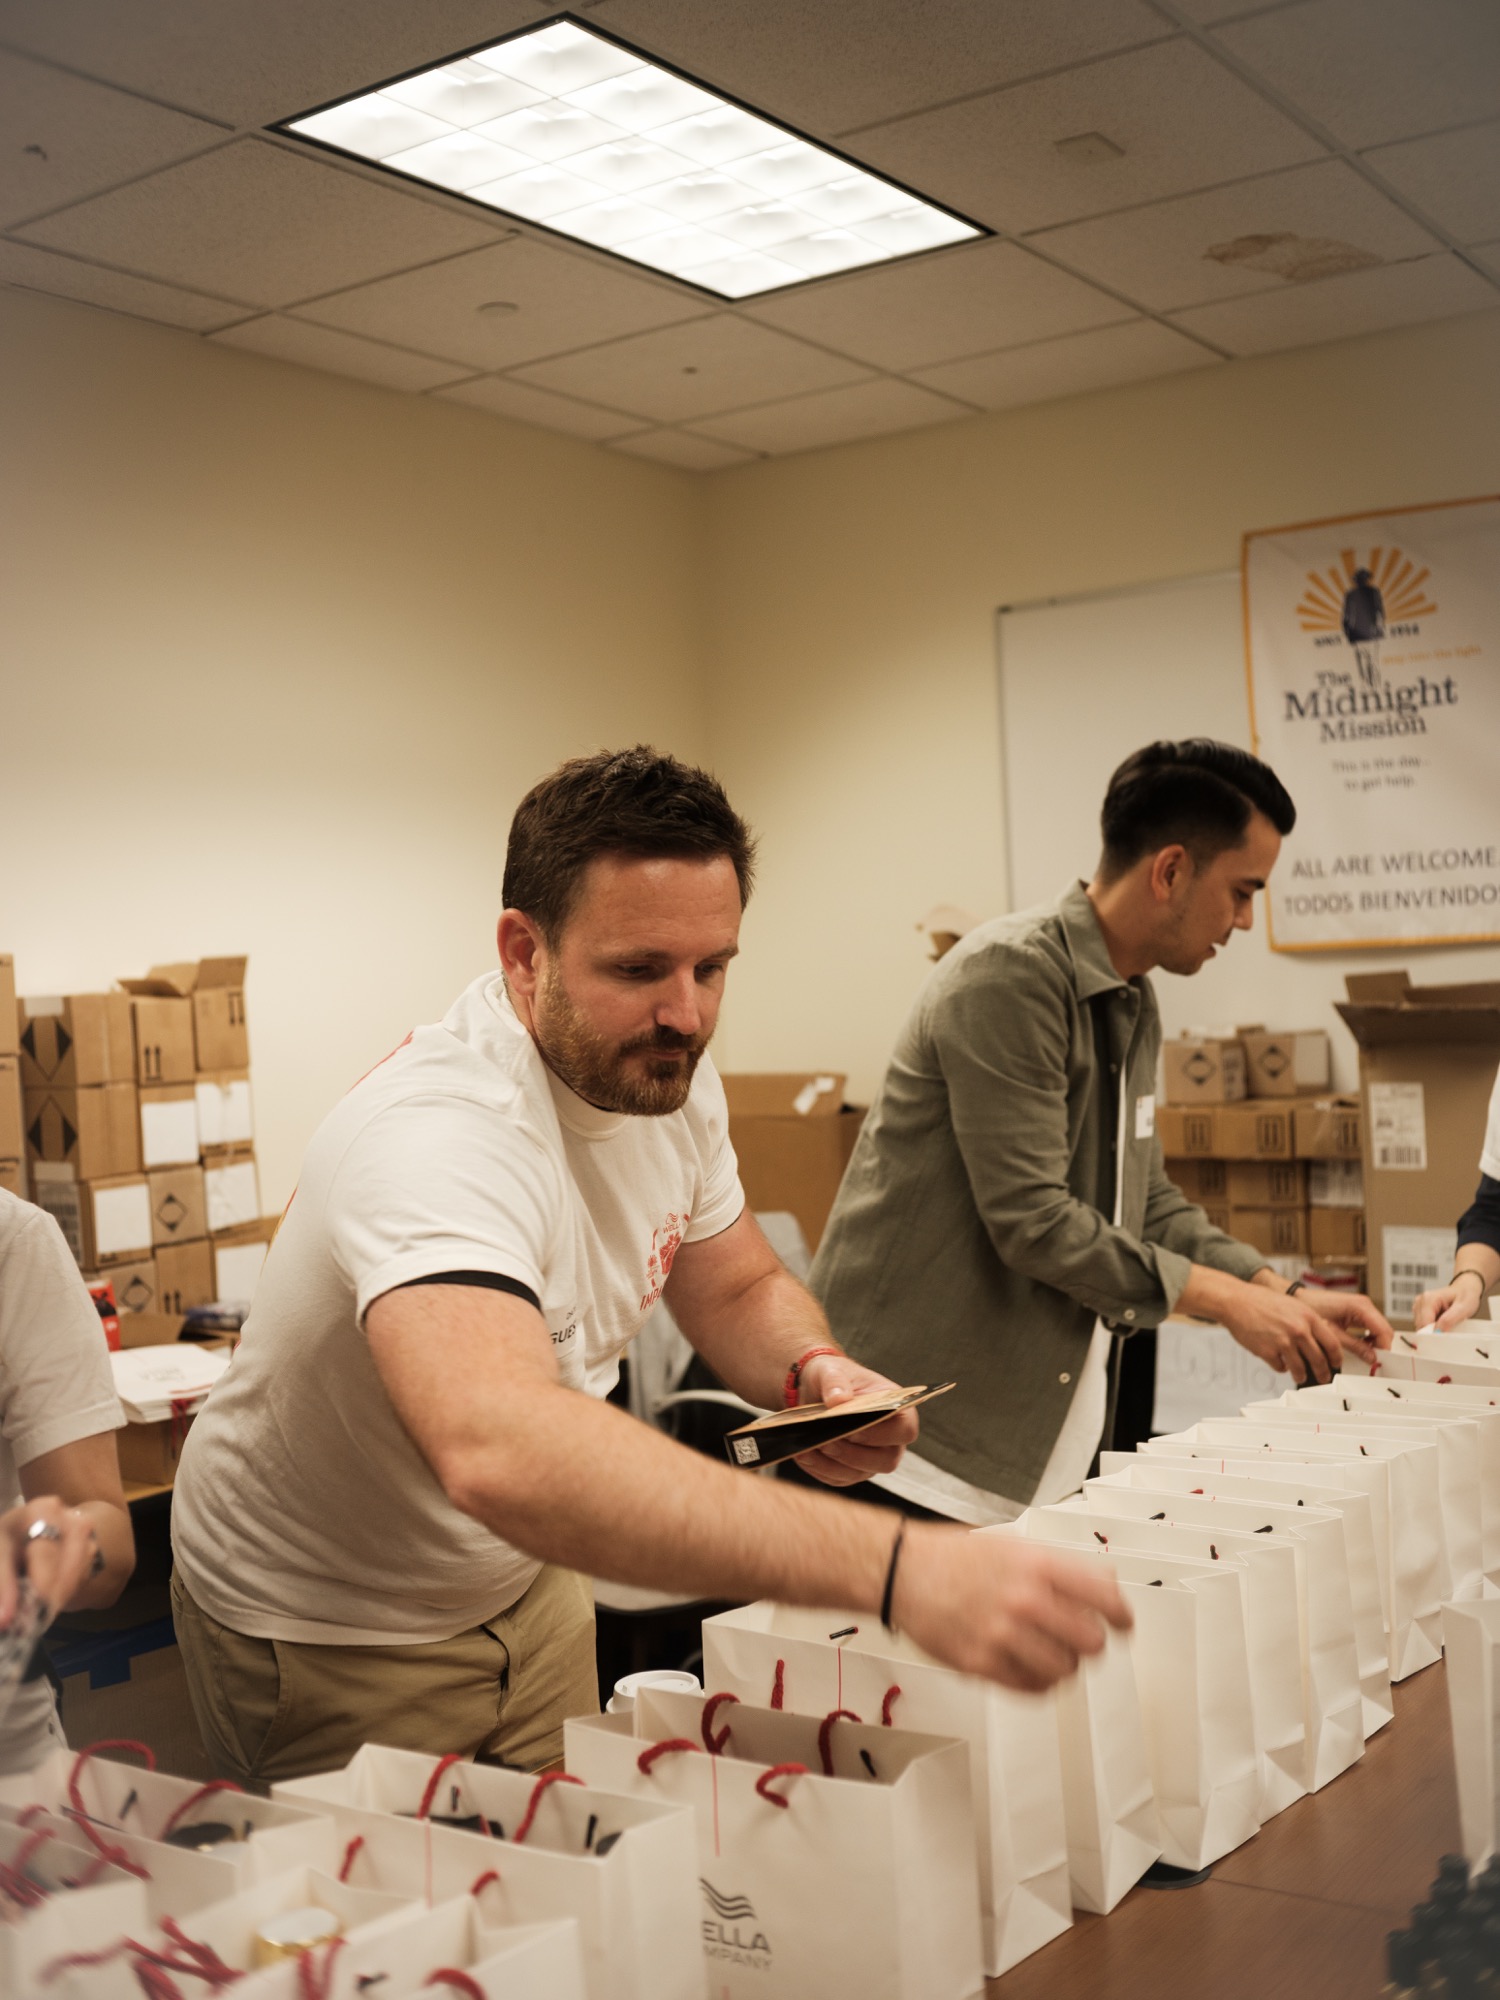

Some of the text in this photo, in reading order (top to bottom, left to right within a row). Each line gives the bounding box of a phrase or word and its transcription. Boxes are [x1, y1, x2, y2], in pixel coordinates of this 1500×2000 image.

[1316, 670, 1351, 688] The
[1284, 675, 1458, 721] Midnight
[1320, 716, 1427, 744] Mission
[1291, 859, 1325, 880] ALL
[1332, 856, 1373, 877] ARE
[1285, 883, 1500, 916] TODOS BIENVENIDO
[663, 1222, 681, 1234] WELL
